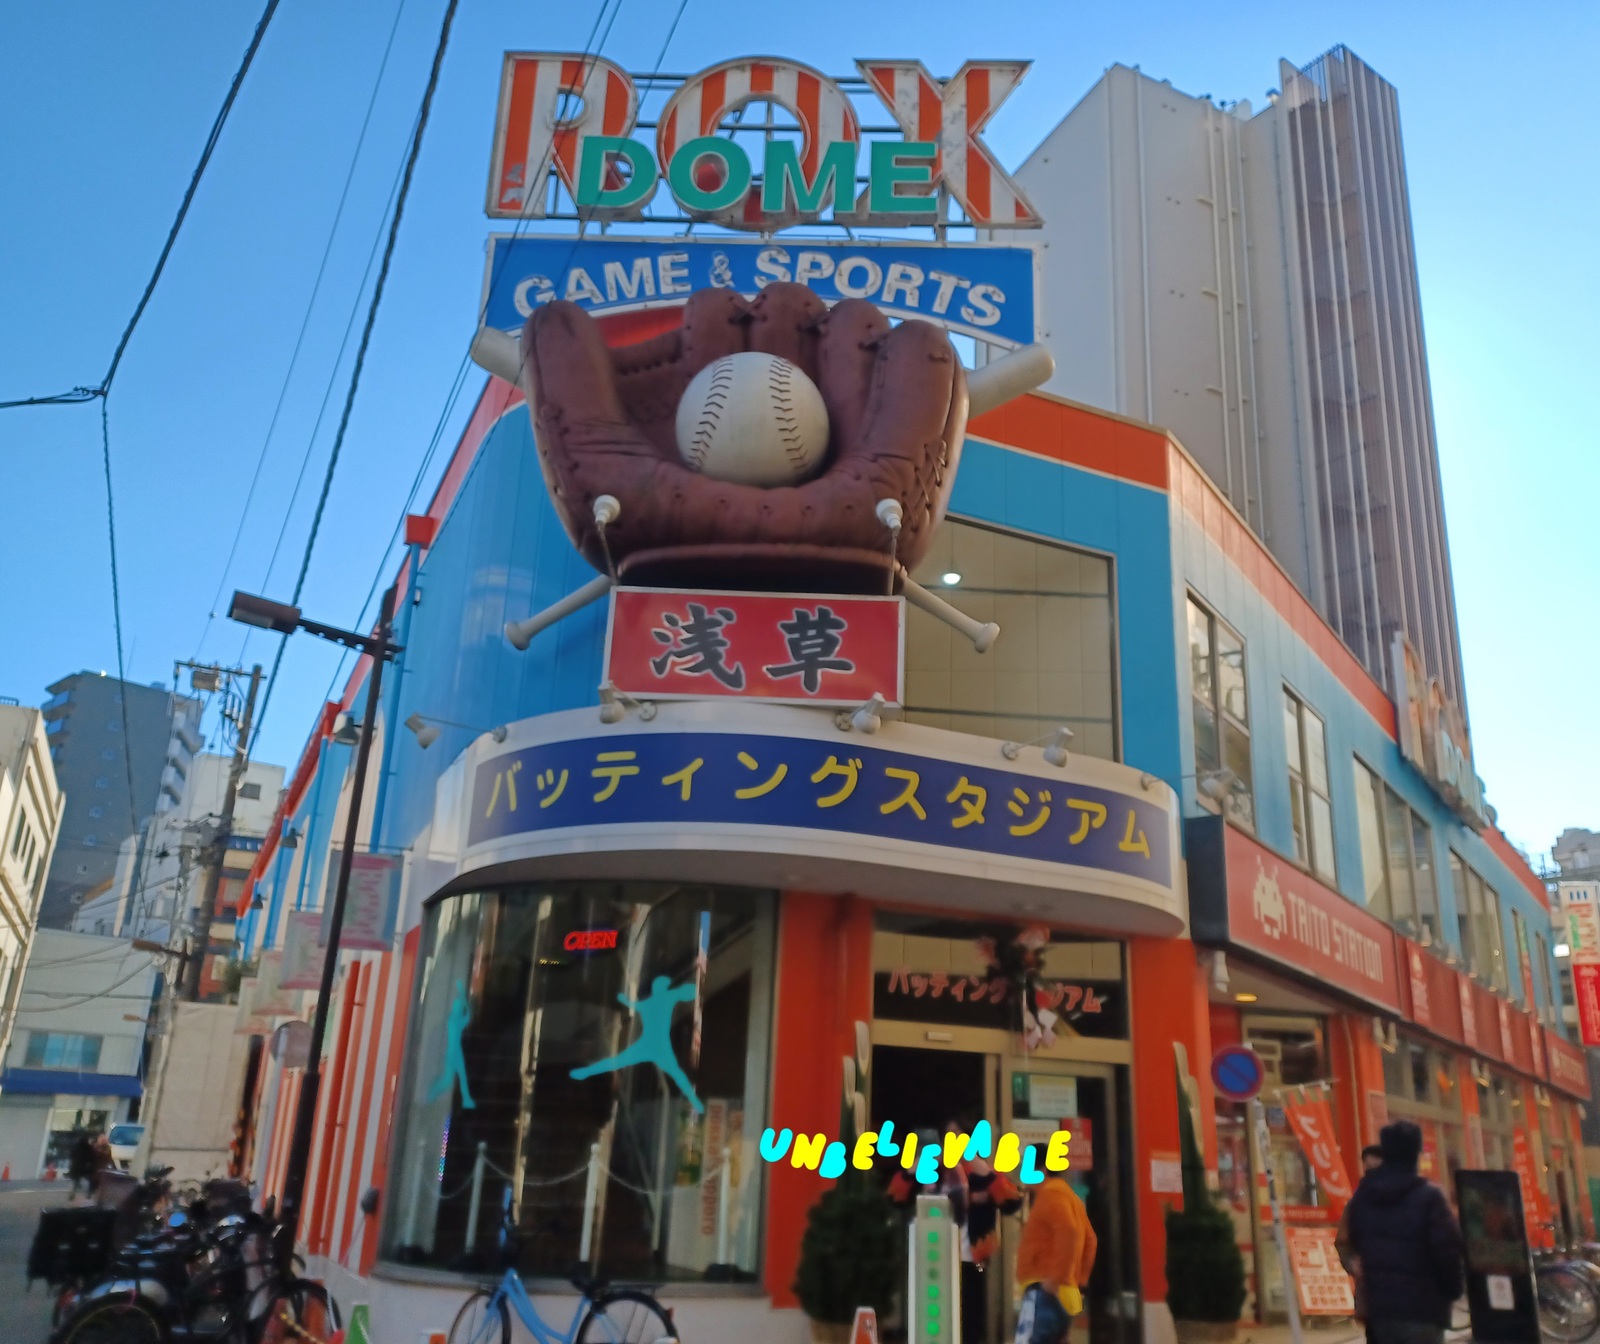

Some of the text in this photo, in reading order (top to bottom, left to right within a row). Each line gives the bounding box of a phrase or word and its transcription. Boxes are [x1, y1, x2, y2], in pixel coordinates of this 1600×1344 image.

[577, 134, 939, 213] DOME
[513, 248, 1006, 326] GAME & SPORTS
[650, 603, 856, 694] 浅草
[486, 750, 1151, 860] バッティングスタジアム
[563, 930, 618, 951] OPEN
[1288, 891, 1383, 984] TAITO STATION
